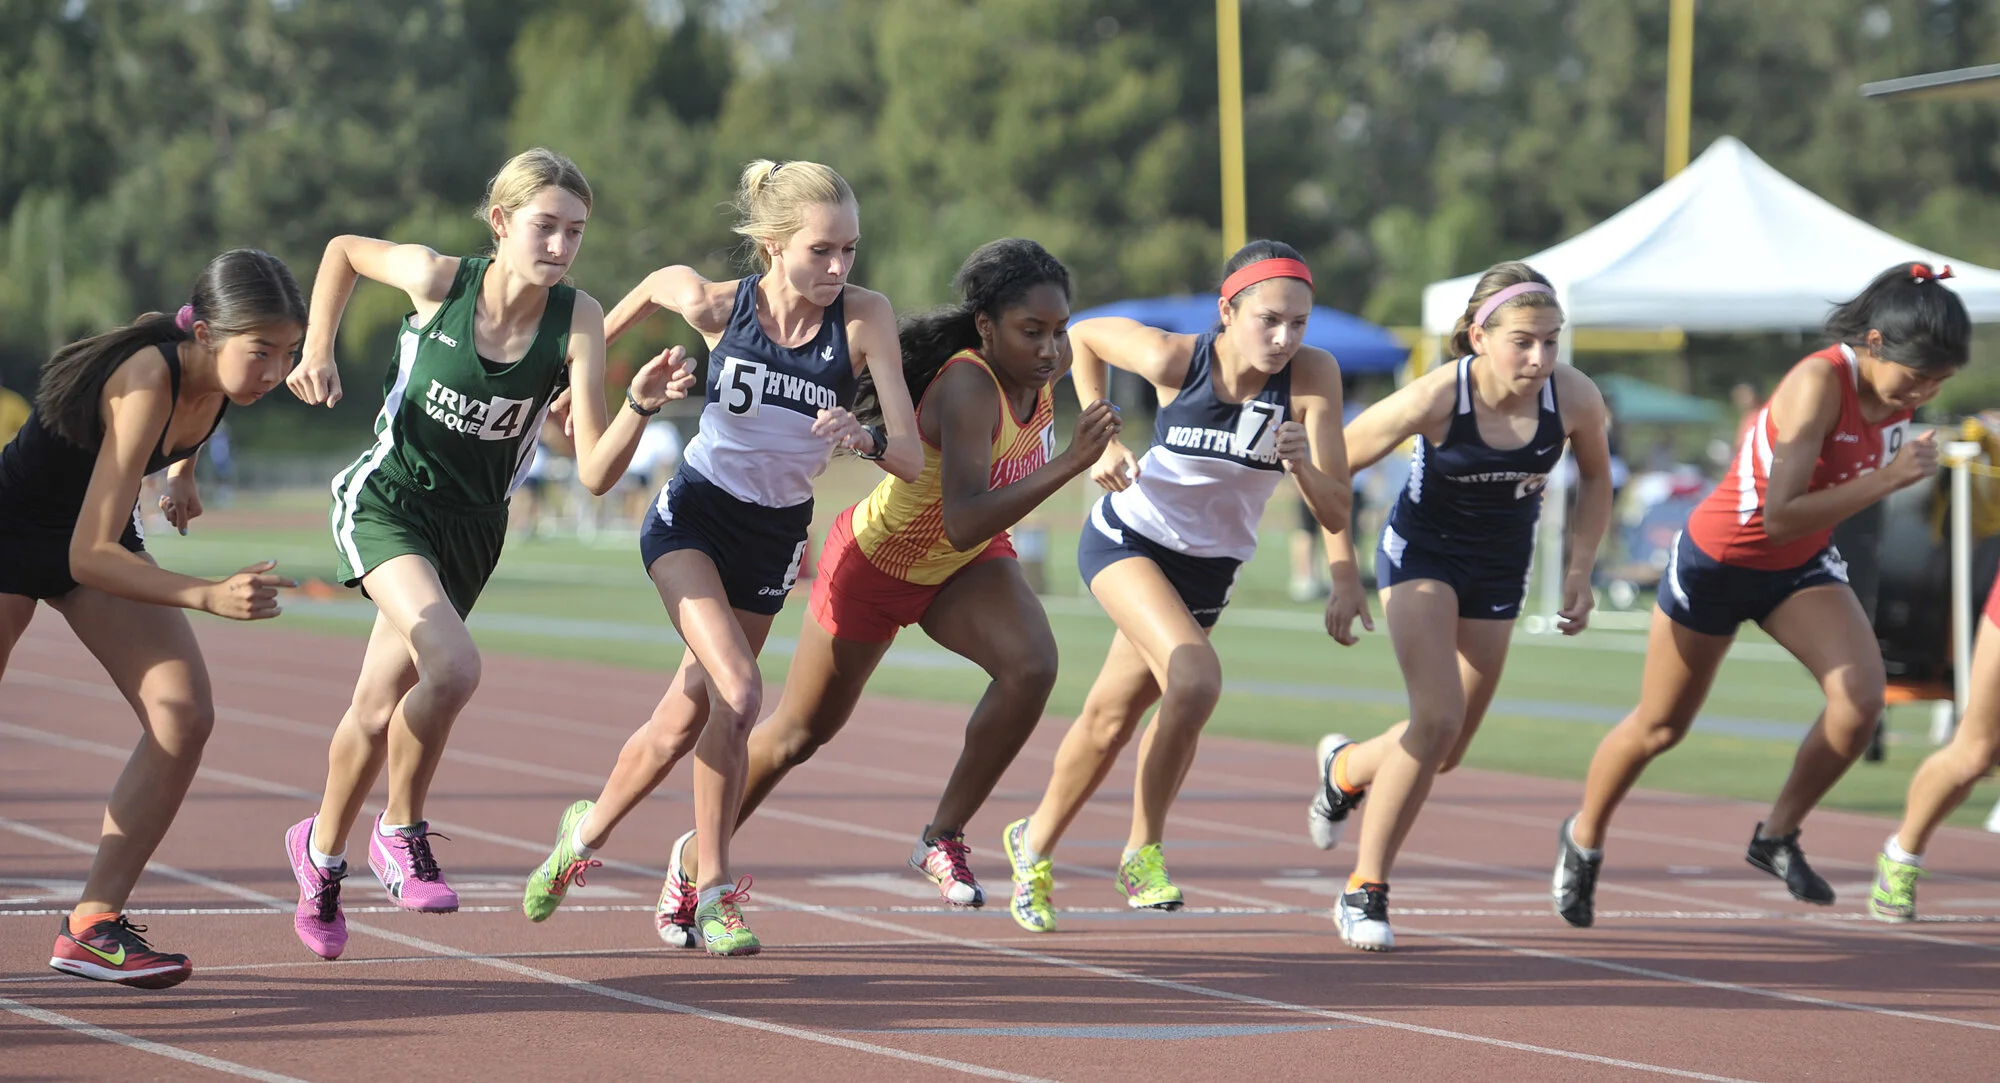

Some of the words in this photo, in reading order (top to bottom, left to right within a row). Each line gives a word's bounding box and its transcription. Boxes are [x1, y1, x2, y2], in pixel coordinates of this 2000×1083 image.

[425, 379, 491, 421] IRVI
[728, 363, 757, 414] 5
[764, 370, 838, 410] HWOOD
[425, 400, 484, 436] VAQUE
[490, 403, 523, 437] 4
[1246, 406, 1276, 450] 7
[1446, 471, 1534, 483] UNIVERS
